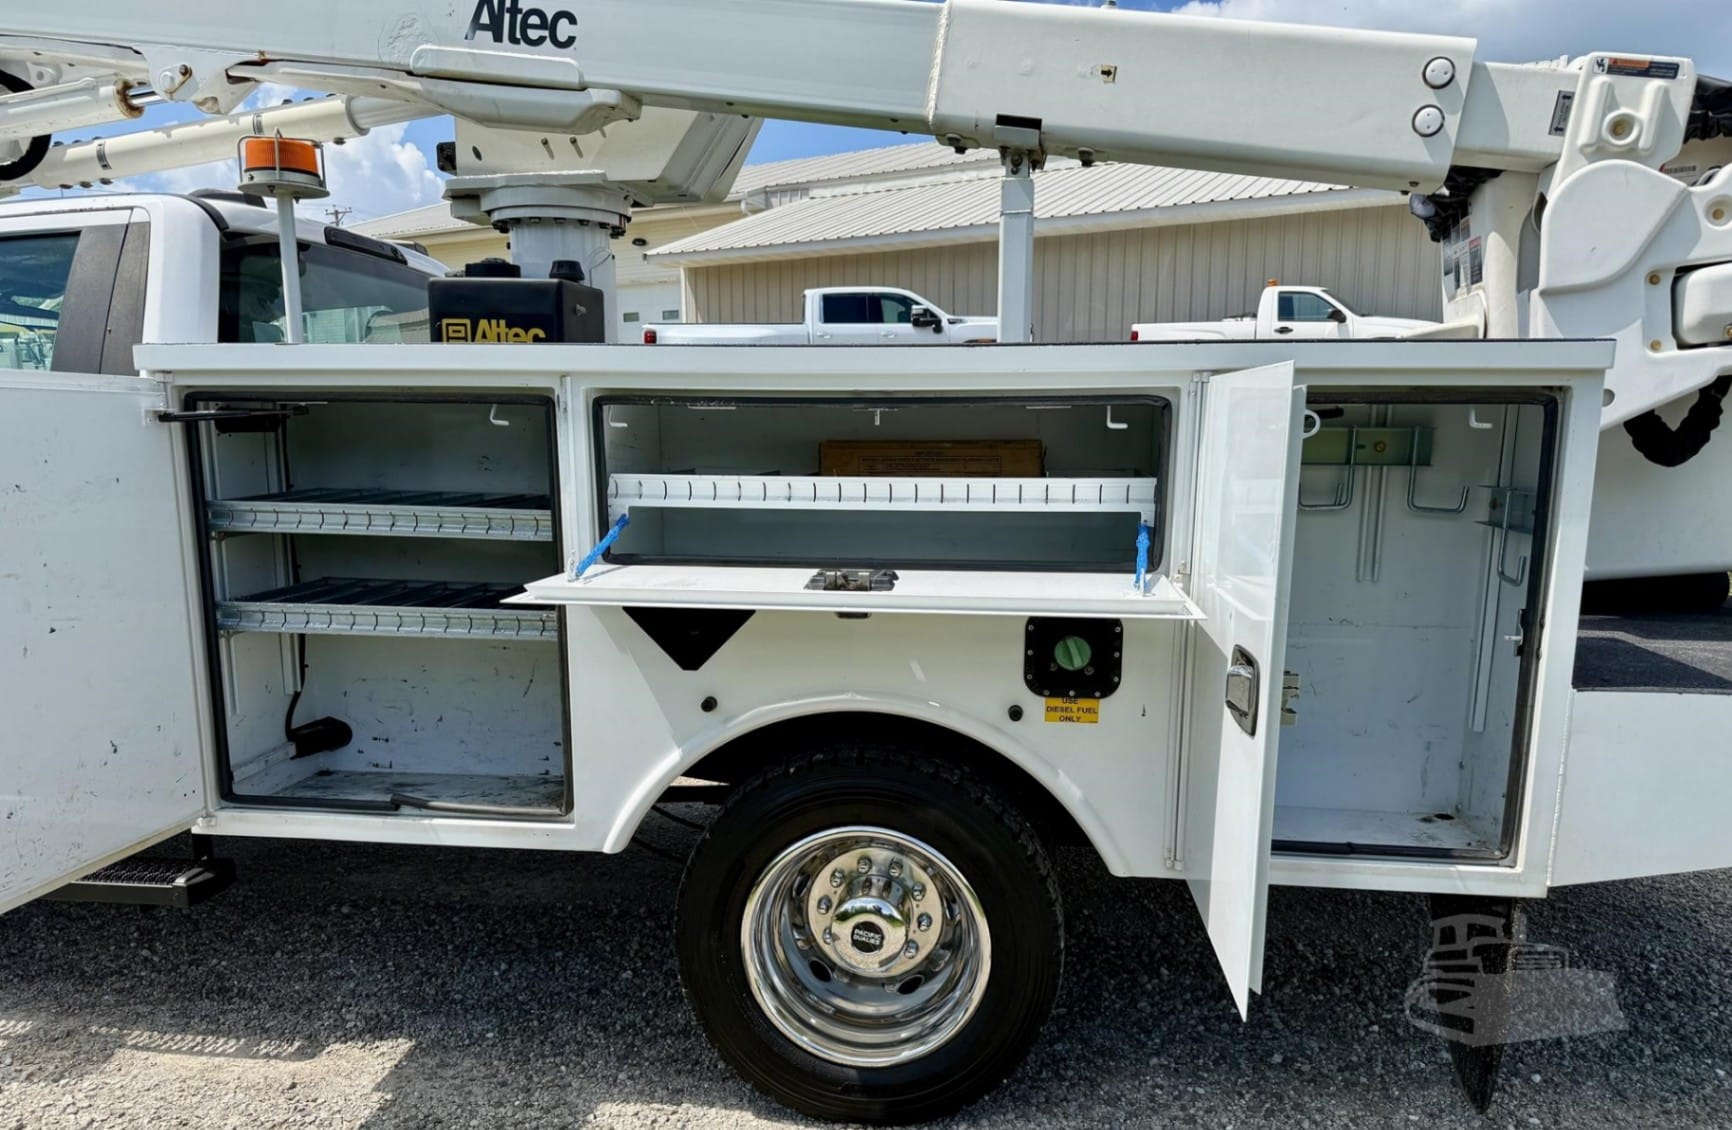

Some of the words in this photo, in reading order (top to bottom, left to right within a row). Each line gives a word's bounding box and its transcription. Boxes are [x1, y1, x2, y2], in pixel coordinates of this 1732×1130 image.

[464, 0, 577, 49] Altec
[475, 319, 546, 343] Altec
[854, 928, 881, 941] PACIFIC
